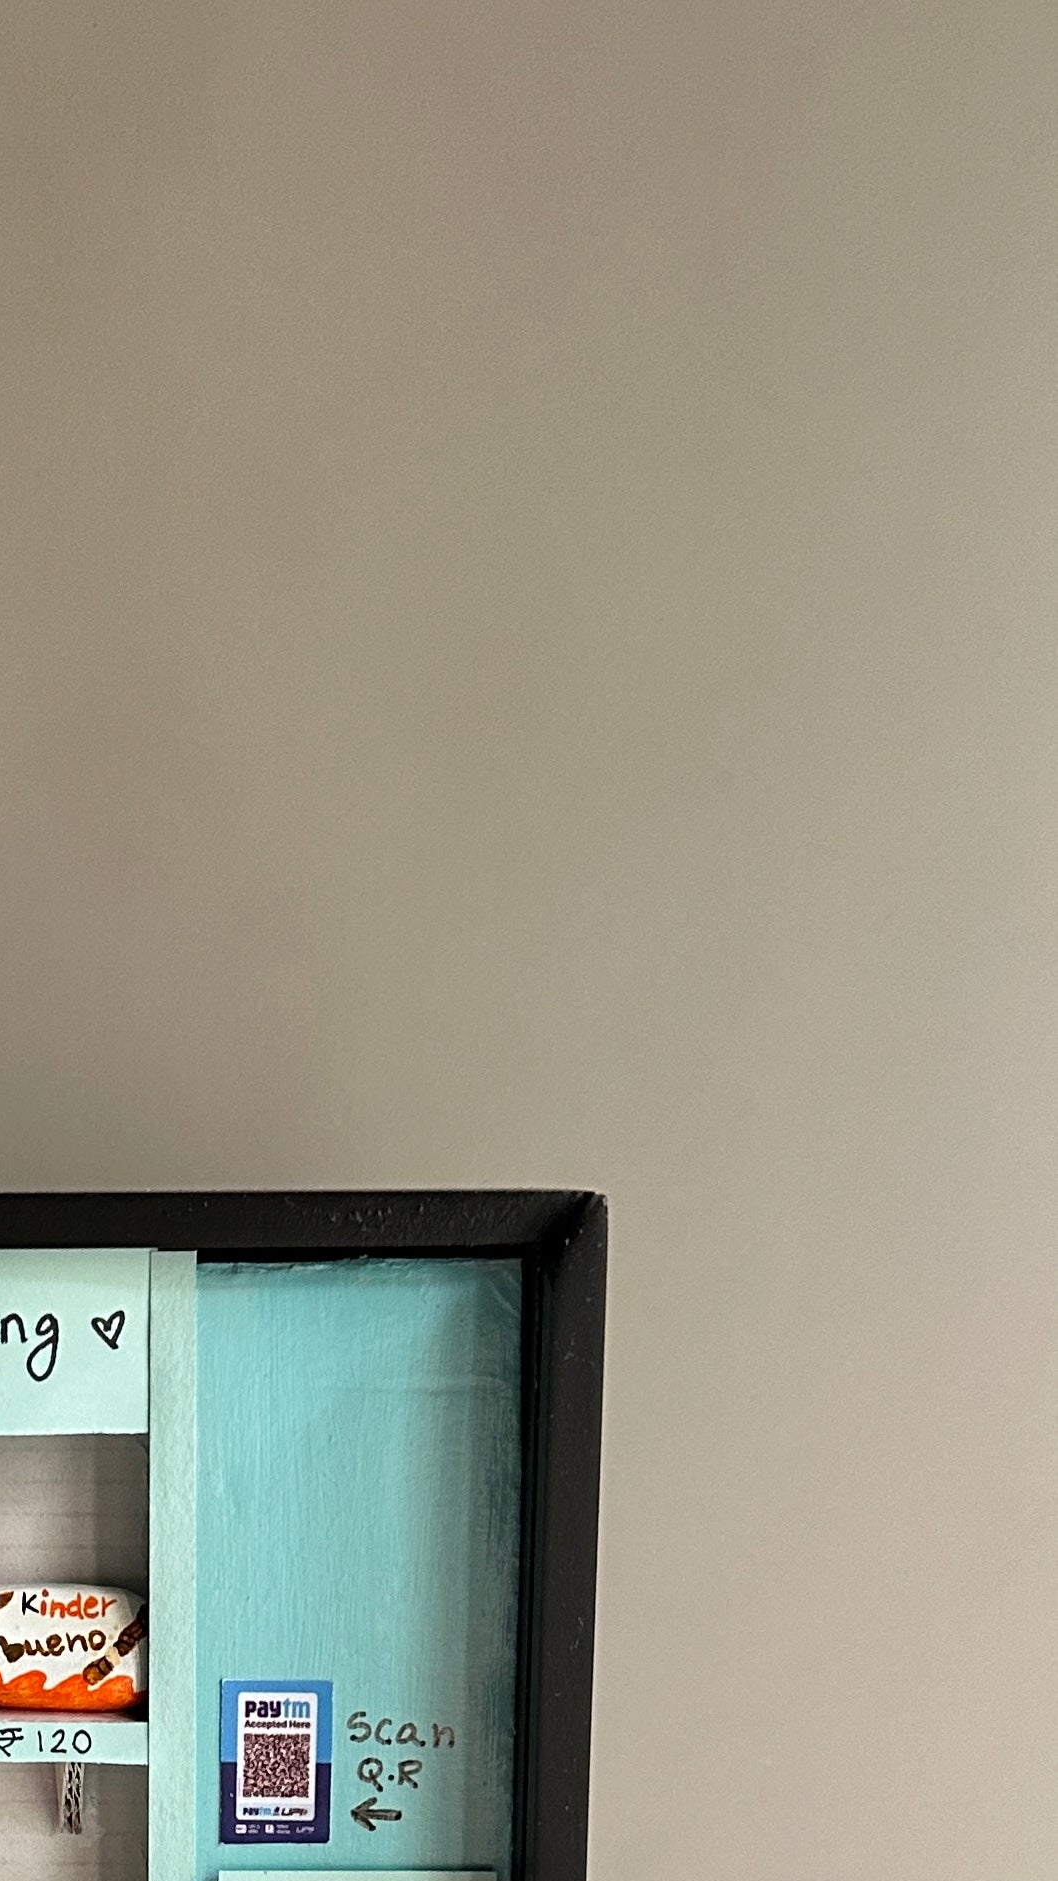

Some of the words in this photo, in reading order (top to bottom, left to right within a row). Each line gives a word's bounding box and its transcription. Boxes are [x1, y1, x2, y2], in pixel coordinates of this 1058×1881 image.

[21, 1589, 118, 1619] Kinder
[244, 1719, 288, 1730] Accepted
[289, 1719, 311, 1729] Here
